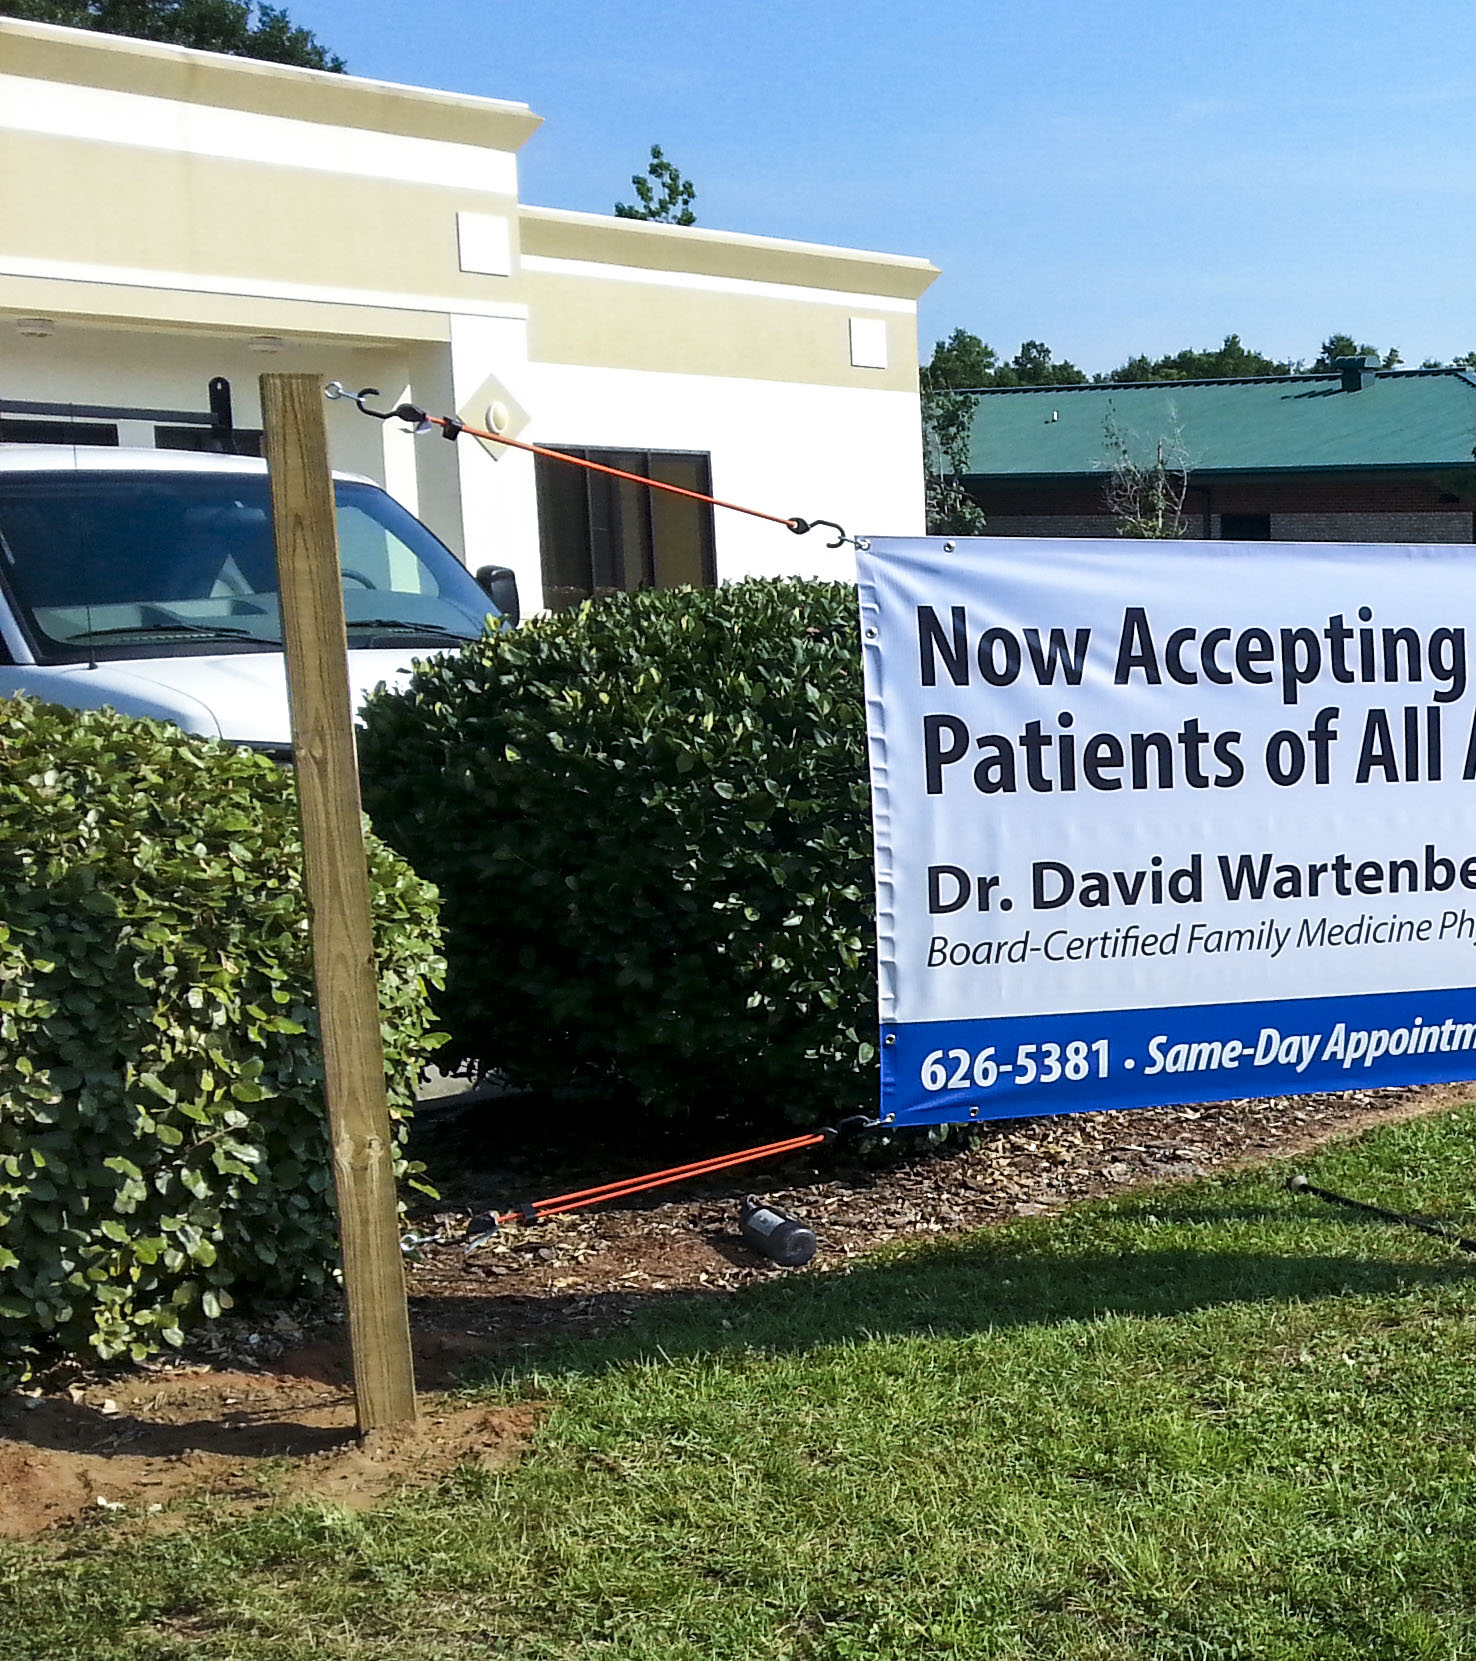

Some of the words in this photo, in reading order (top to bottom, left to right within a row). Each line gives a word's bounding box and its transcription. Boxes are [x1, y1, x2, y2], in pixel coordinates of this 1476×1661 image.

[917, 604, 1092, 687] Now
[1114, 605, 1467, 705] Accepting
[923, 711, 1245, 795] Patients
[1265, 706, 1340, 787] of
[1355, 705, 1442, 784] All
[927, 864, 1014, 915] Dr.
[1032, 853, 1202, 910] David
[926, 923, 1181, 968] Board-Certified
[1186, 919, 1291, 959] Family
[1296, 913, 1433, 949] Medicine
[920, 1038, 1110, 1092] 626-5381
[1143, 1027, 1321, 1076] Same-Day
